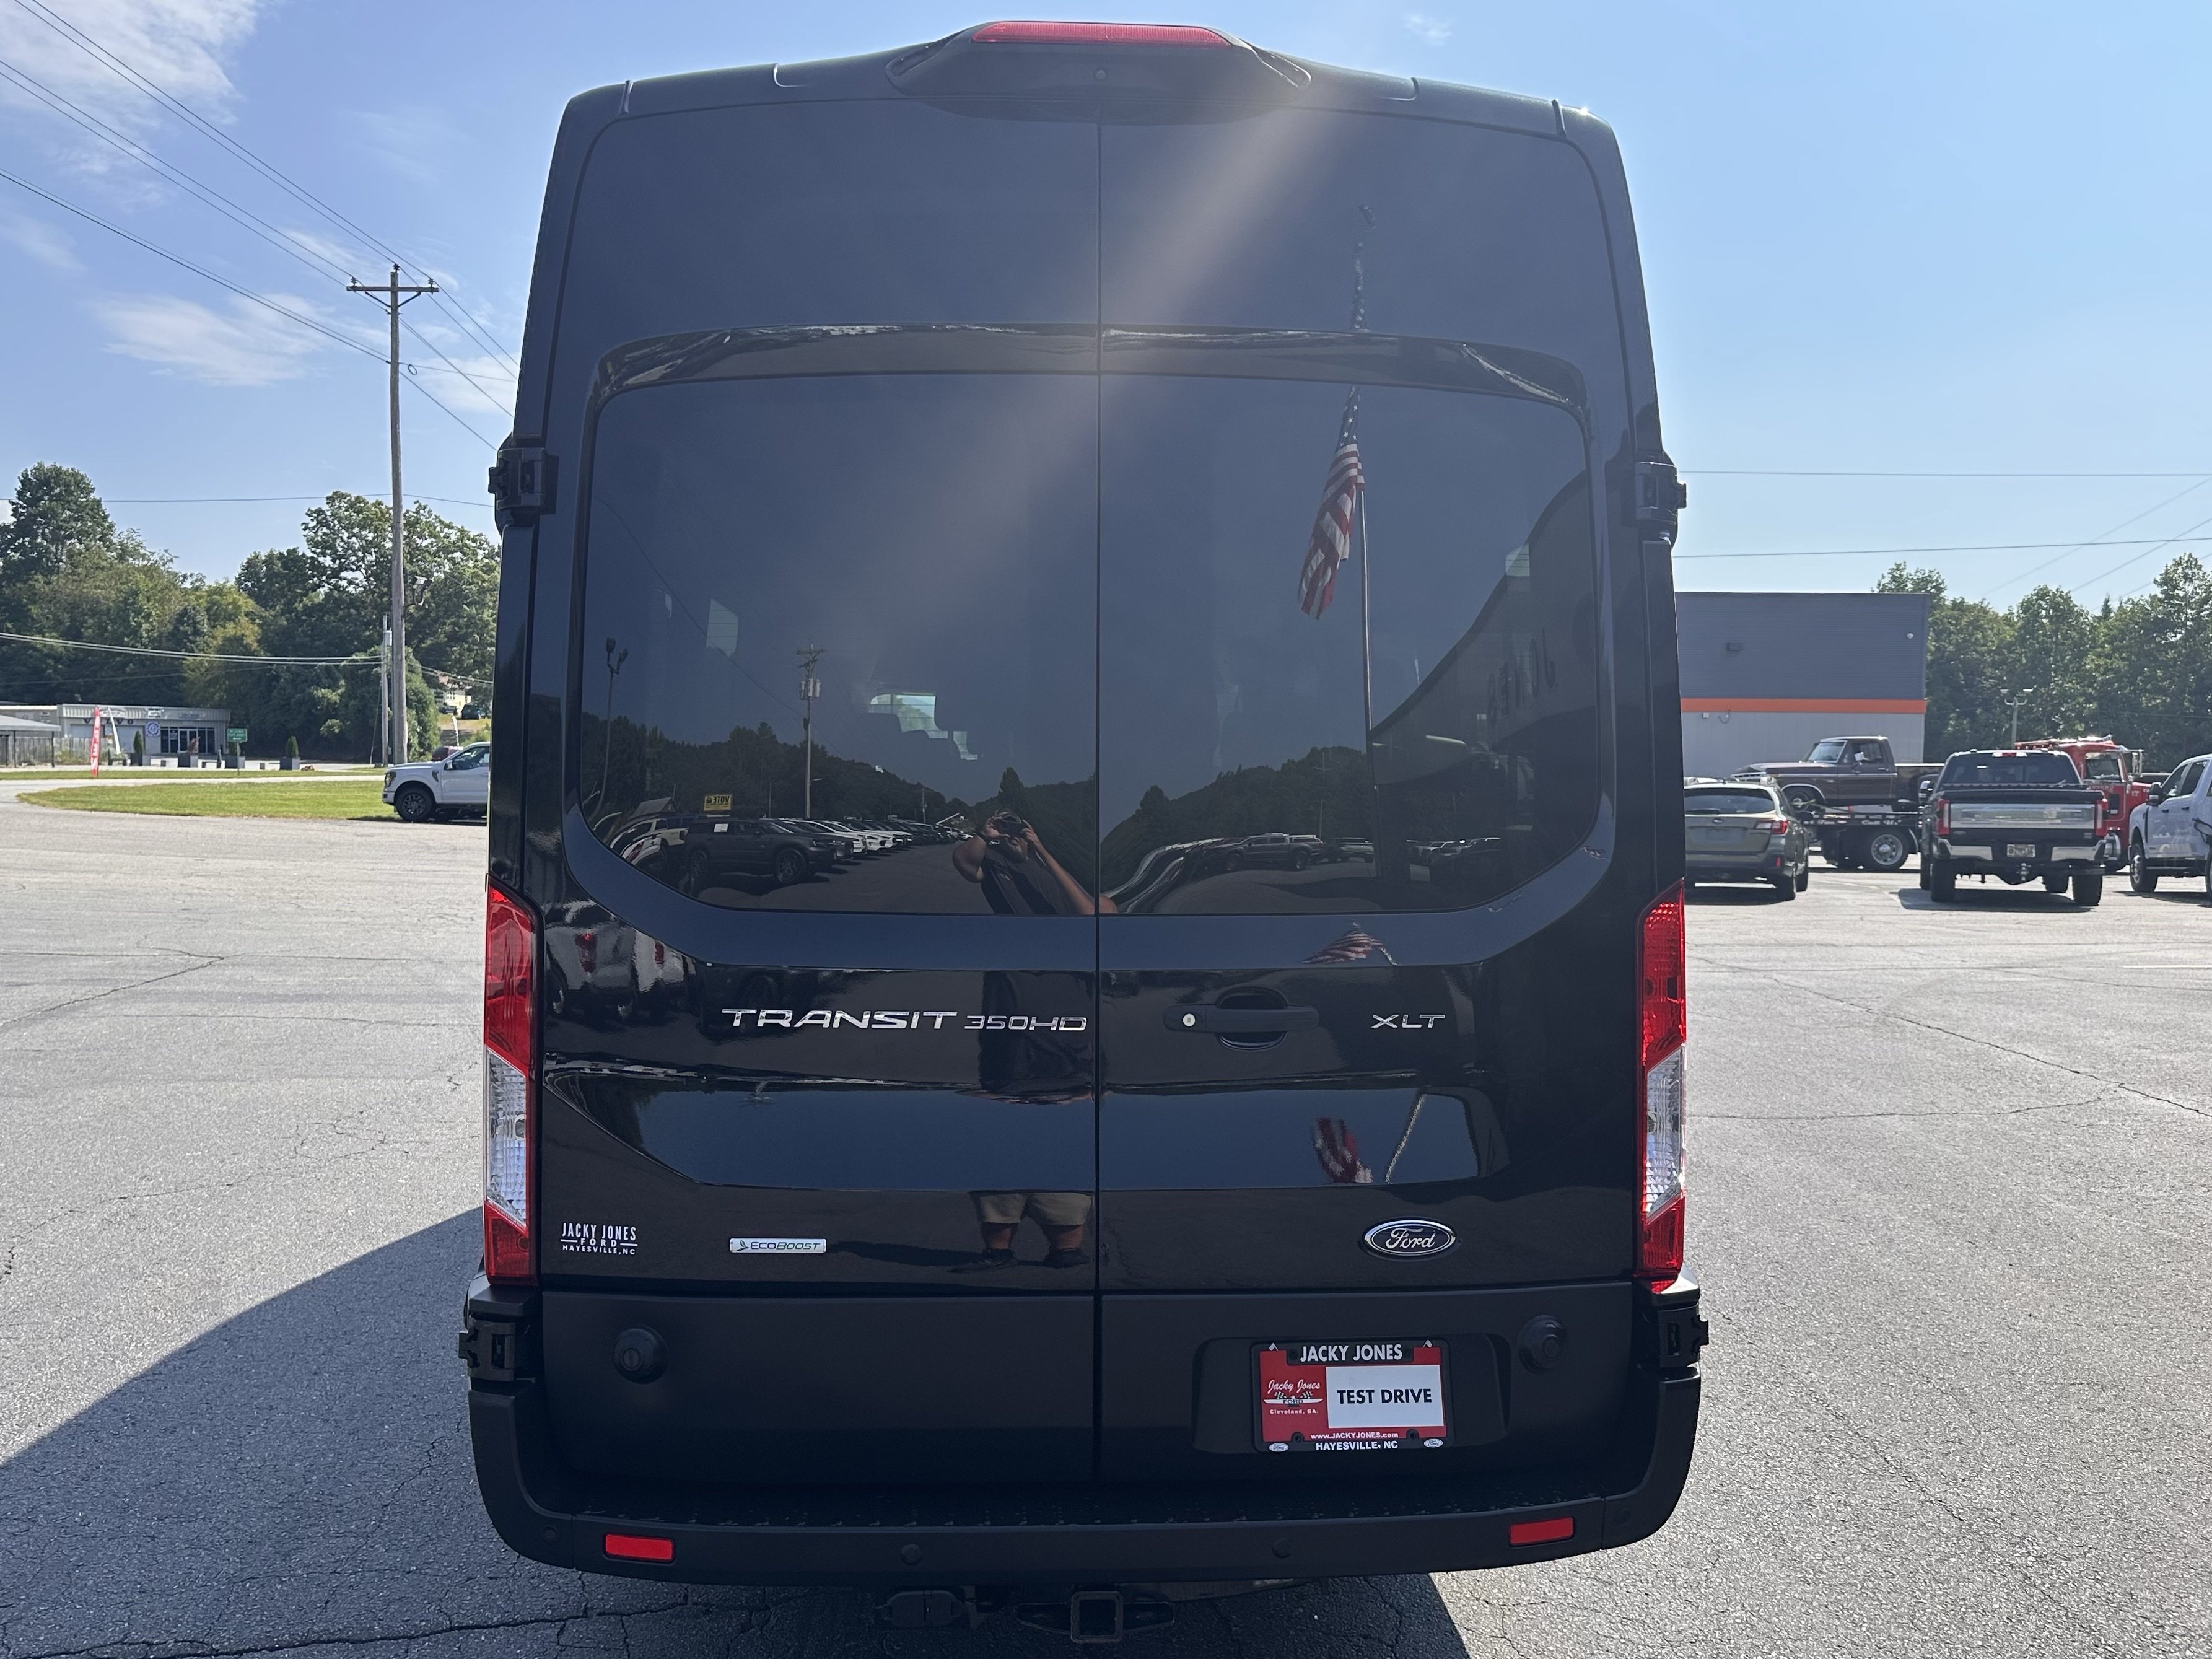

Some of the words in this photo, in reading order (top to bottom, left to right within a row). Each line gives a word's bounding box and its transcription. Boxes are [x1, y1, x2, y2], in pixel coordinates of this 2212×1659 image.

[722, 1009, 958, 1030] TRANSIT
[964, 1015, 1087, 1031] 350HD
[1371, 1014, 1446, 1029] XLT
[562, 1222, 597, 1238] JACKY
[601, 1225, 636, 1241] JONES
[1385, 1227, 1436, 1249] Ford
[580, 1238, 617, 1248] FORD
[1300, 1345, 1349, 1362] JACKY
[1353, 1344, 1403, 1361] JONES
[1267, 1379, 1294, 1394] Jacky
[1296, 1379, 1321, 1393] Jones
[1337, 1390, 1375, 1404] TEST
[1381, 1388, 1432, 1403] DRIVE
[1310, 1432, 1399, 1440] www.JACKYJONES.com
[1315, 1440, 1381, 1450] HAYESVILLE,
[1384, 1440, 1398, 1449] NC
